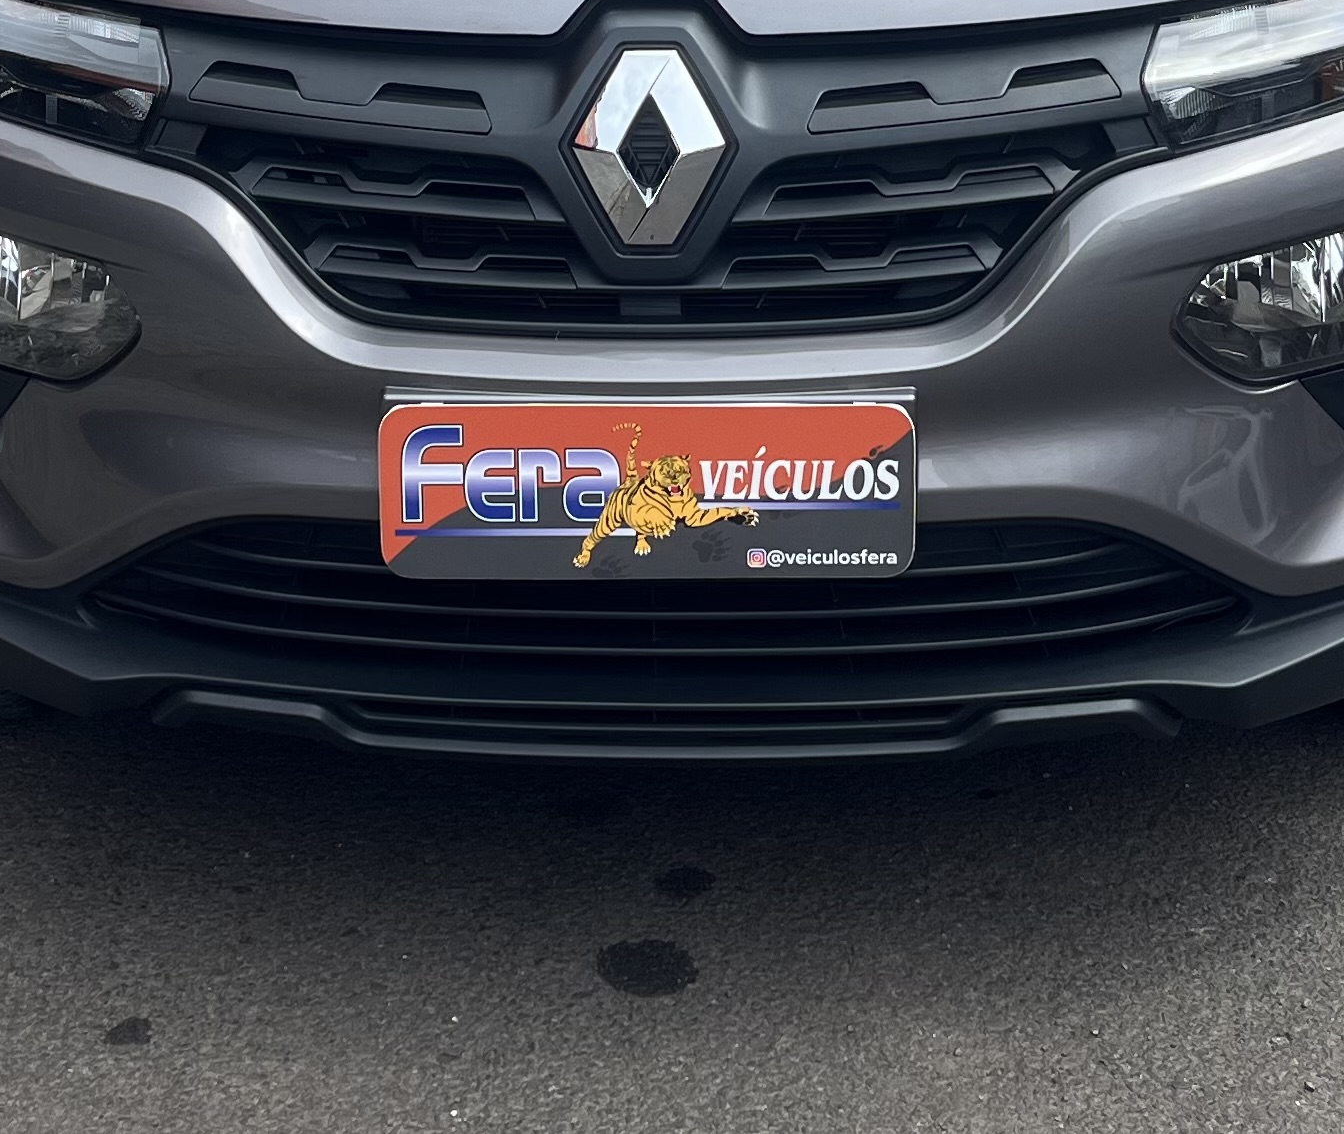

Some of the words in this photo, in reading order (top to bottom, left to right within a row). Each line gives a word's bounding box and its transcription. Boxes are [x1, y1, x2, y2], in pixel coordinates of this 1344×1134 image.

[401, 424, 622, 524] Fera
[699, 445, 900, 502] VEÍCULOS
[767, 548, 898, 568] @veiculosfera
